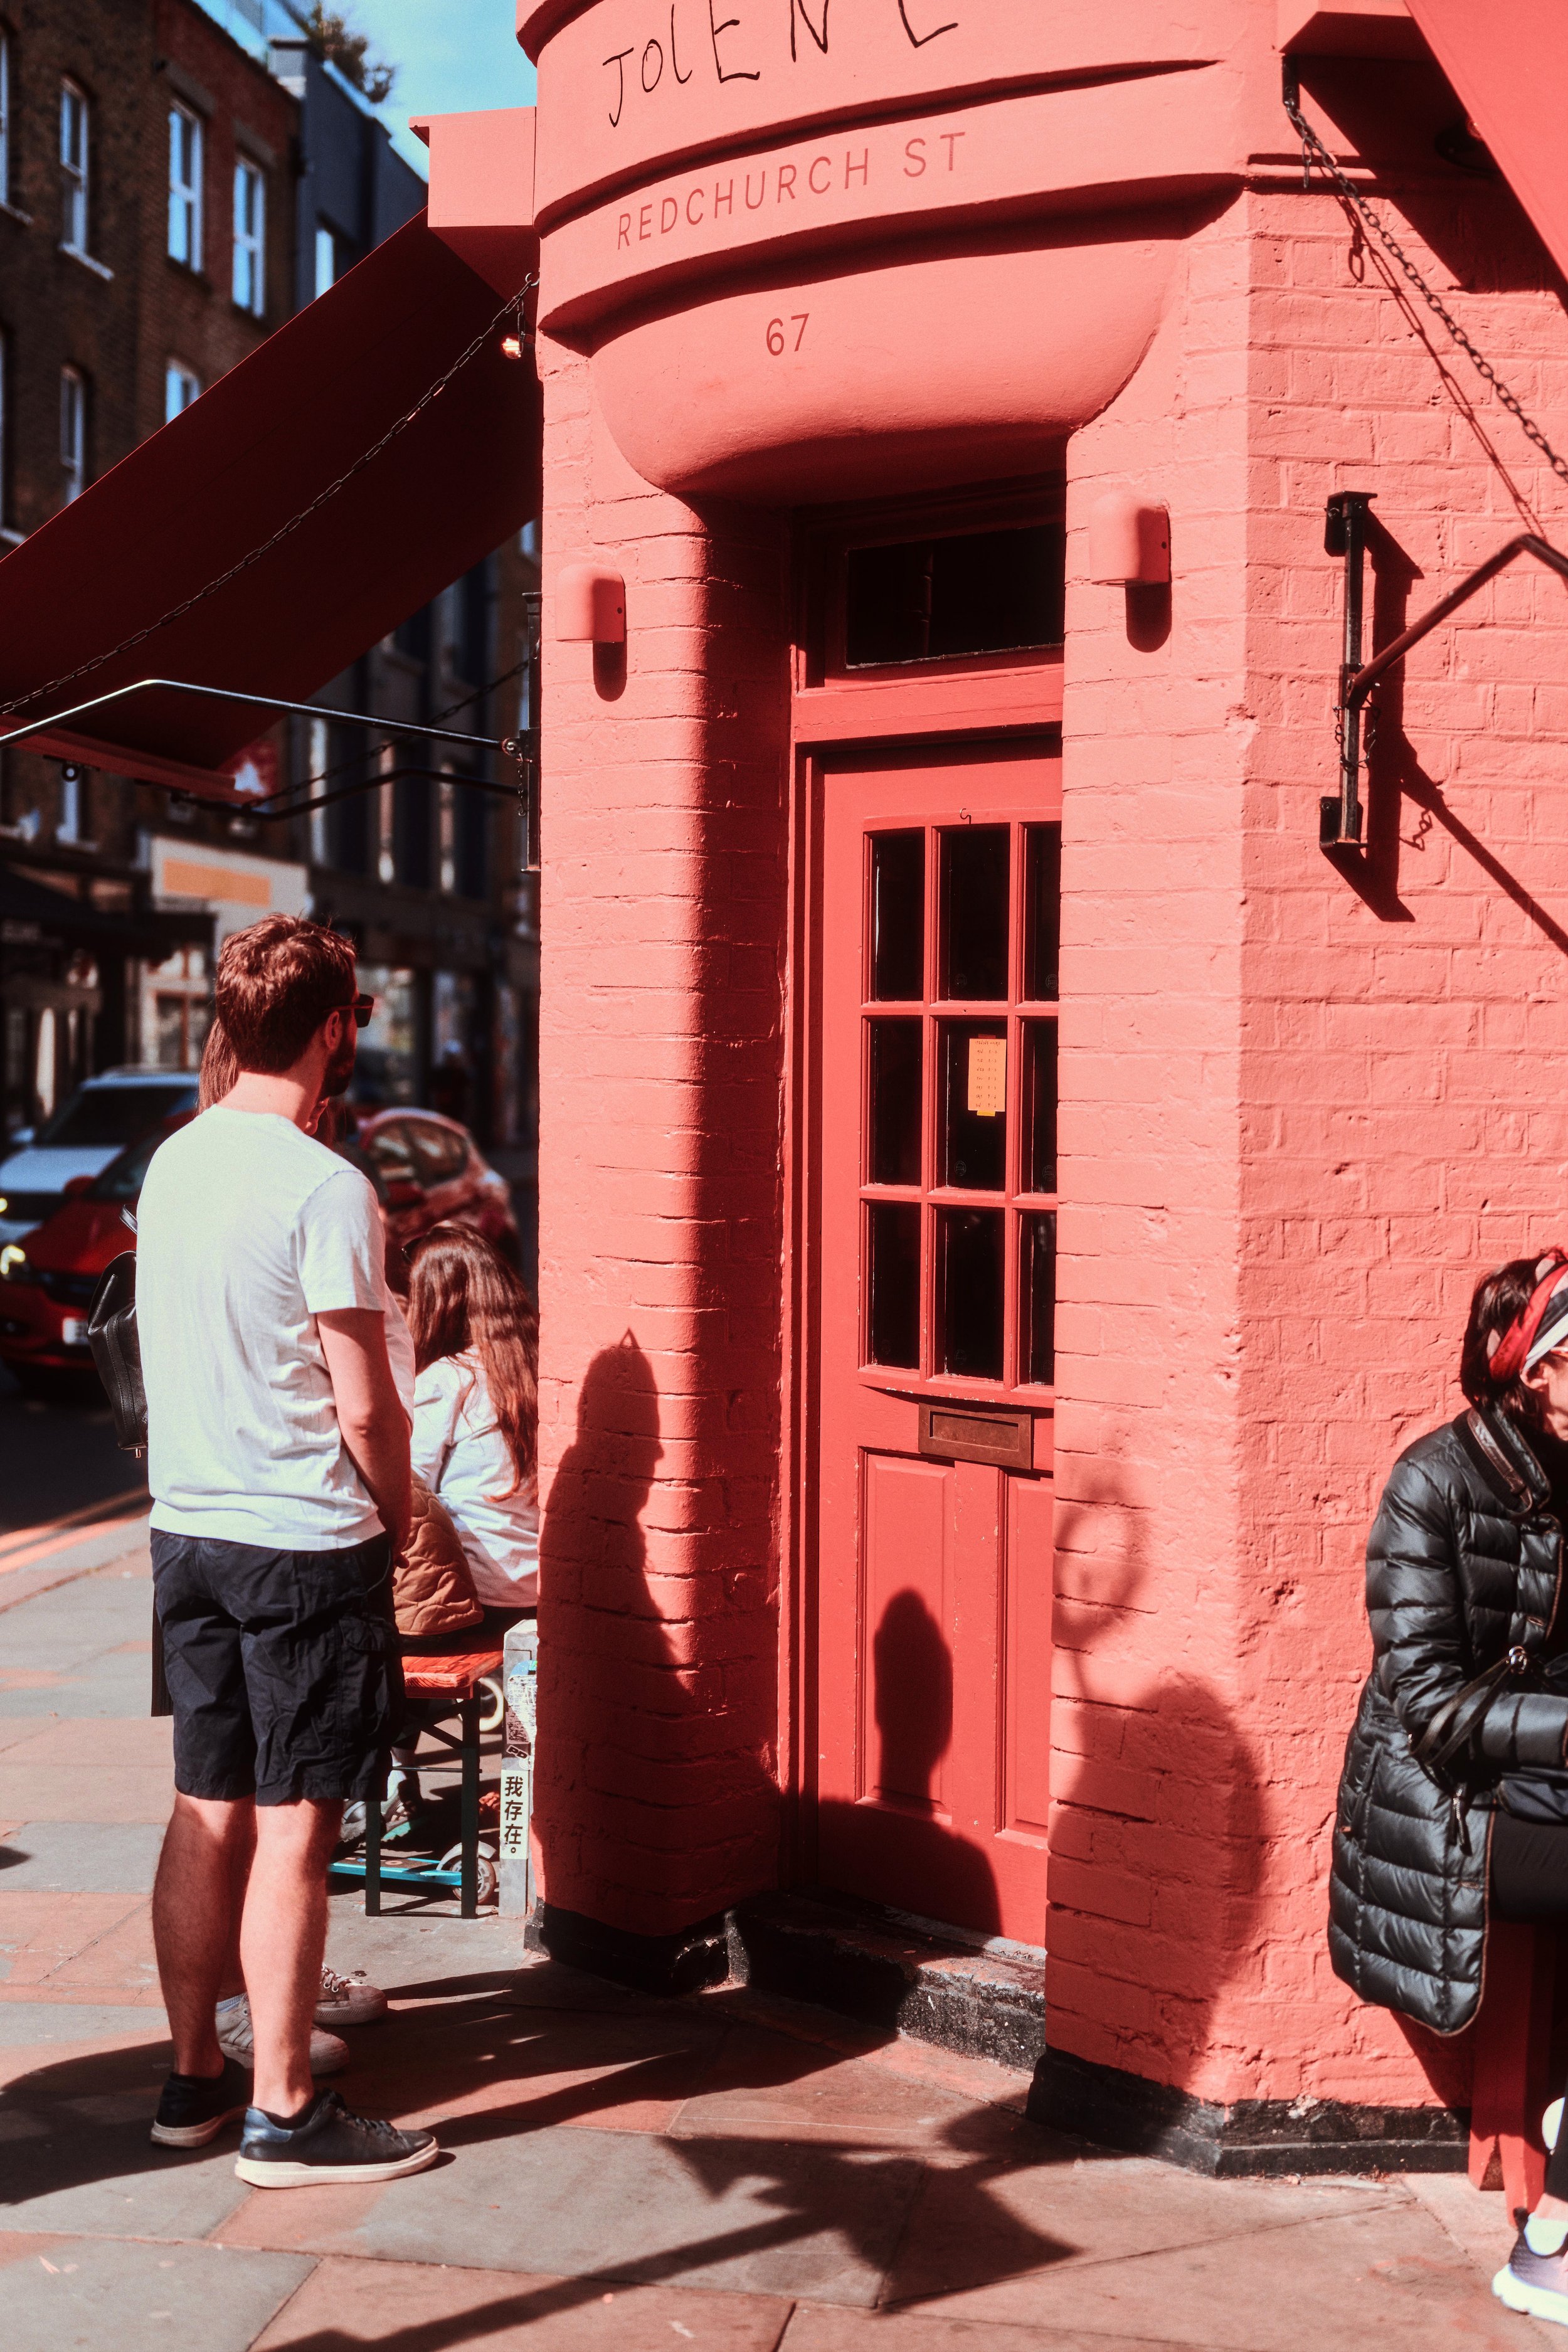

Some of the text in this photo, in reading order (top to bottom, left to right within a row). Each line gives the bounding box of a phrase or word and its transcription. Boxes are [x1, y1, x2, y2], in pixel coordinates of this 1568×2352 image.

[616, 130, 967, 250] REDCHURCH ST
[765, 312, 810, 357] 67
[504, 1776, 524, 1854] 我存在。
